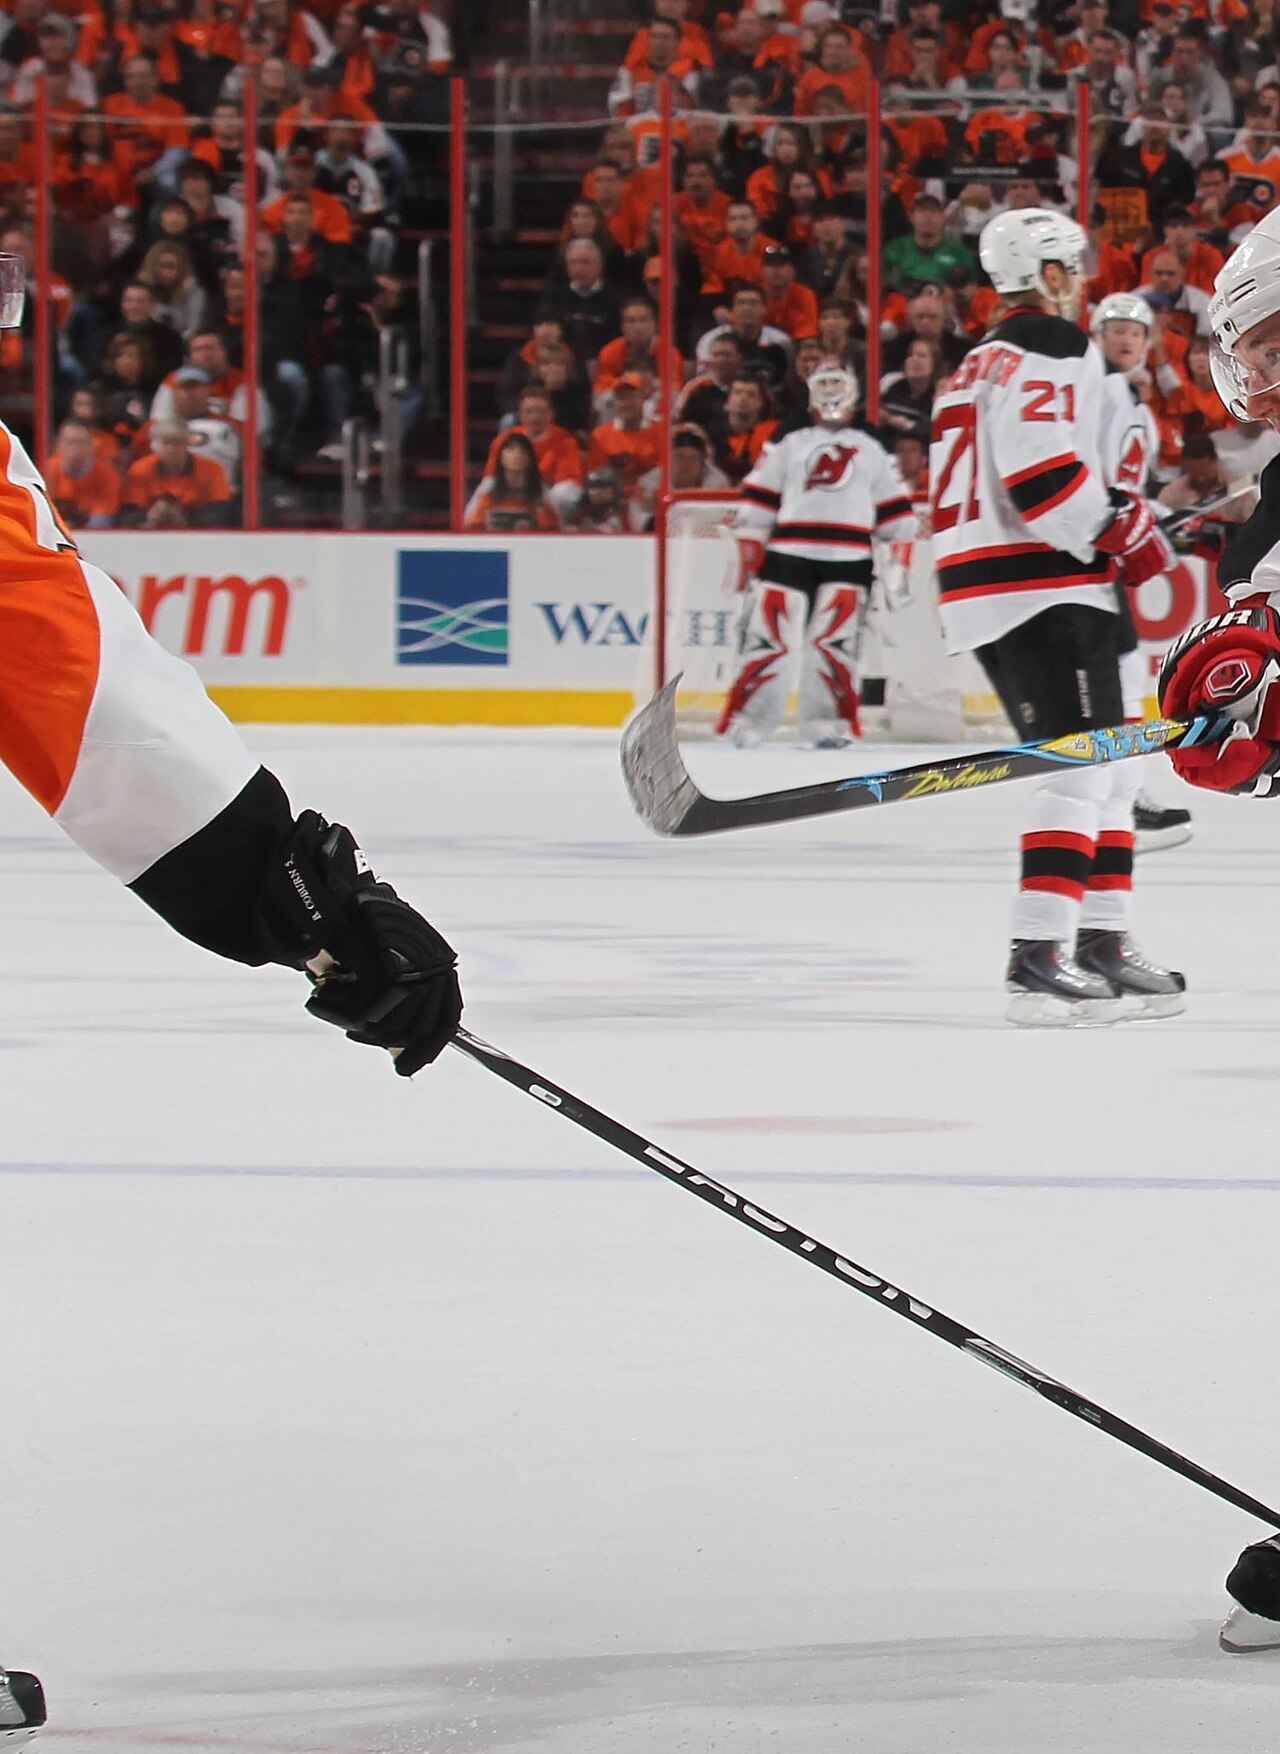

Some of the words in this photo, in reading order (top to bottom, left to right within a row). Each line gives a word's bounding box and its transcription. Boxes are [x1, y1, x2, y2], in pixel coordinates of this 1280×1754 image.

[1020, 380, 1075, 422] 21
[929, 402, 981, 534] 21
[108, 572, 291, 657] rm
[288, 869, 315, 911] COBURN
